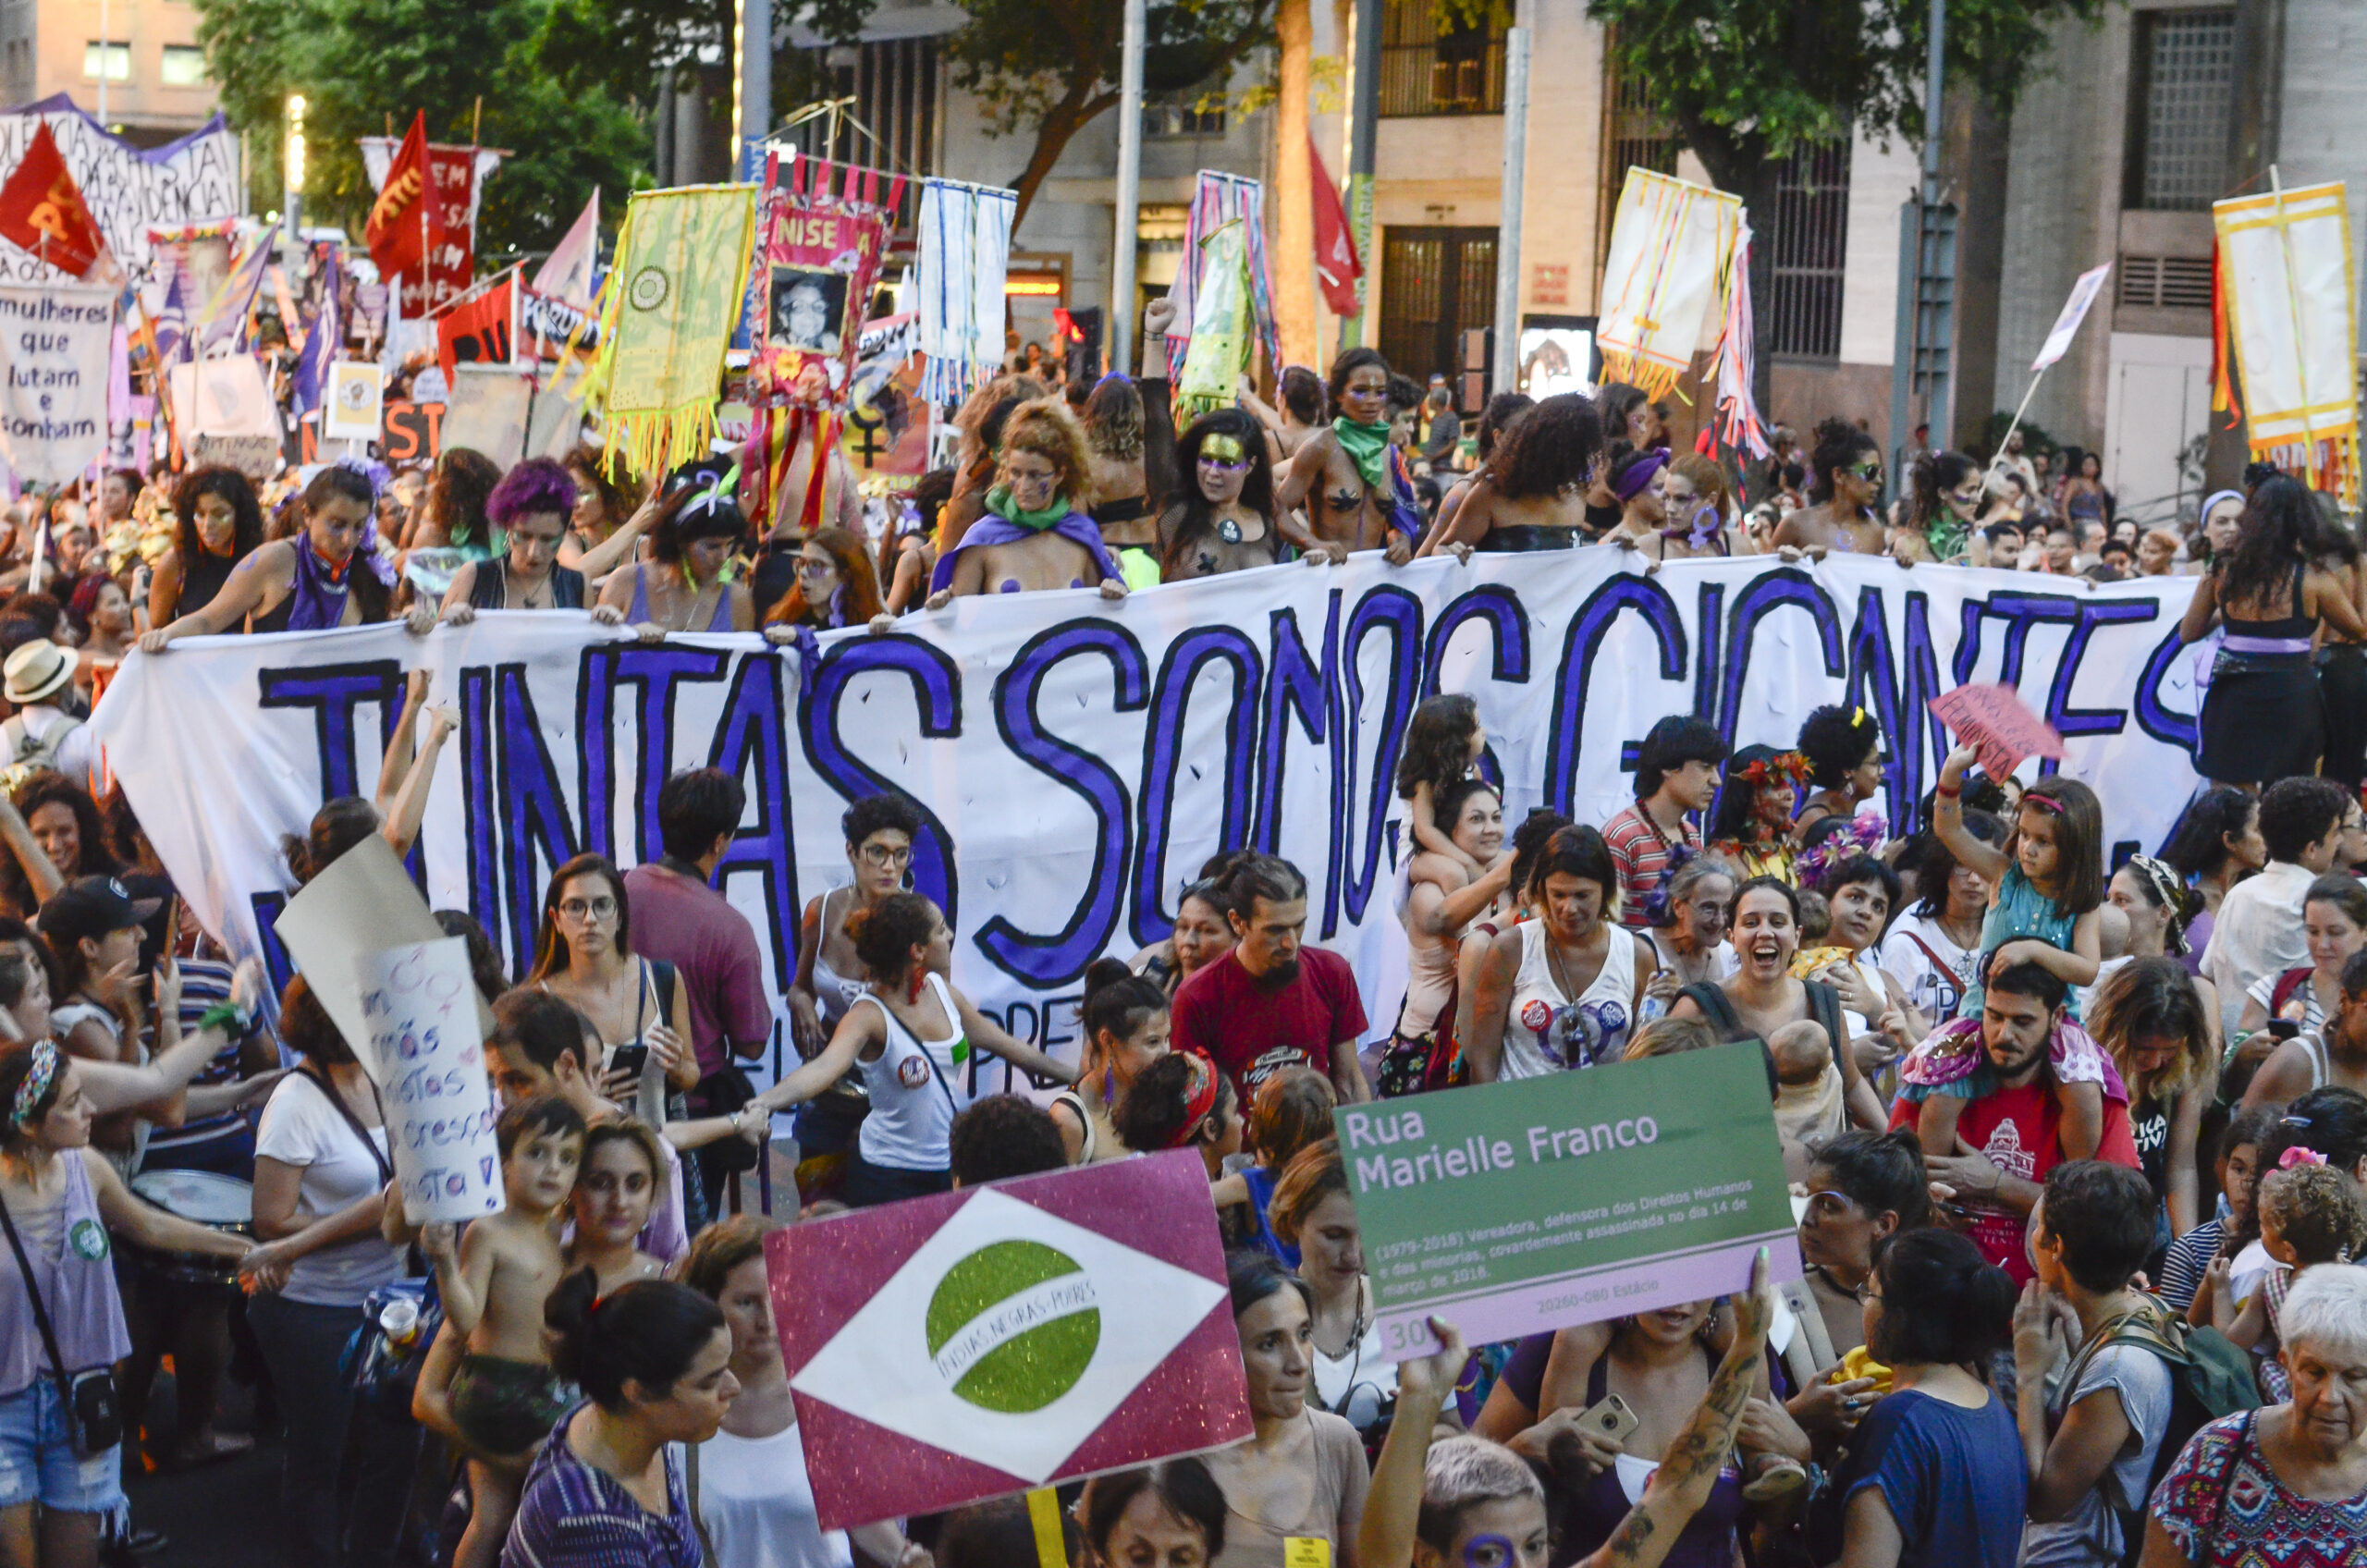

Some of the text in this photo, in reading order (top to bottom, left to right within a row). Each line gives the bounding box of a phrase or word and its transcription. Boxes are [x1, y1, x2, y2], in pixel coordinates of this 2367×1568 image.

[778, 217, 838, 250] NISE
[1354, 180, 1374, 307] ROOVIÁRIA
[0, 298, 107, 323] mulheres
[20, 332, 69, 356] que
[8, 365, 80, 387] lutam
[40, 394, 52, 410] e
[974, 583, 1531, 989] SOMOS
[1345, 1110, 1426, 1149] Rua
[1355, 1115, 1659, 1194] Marielle Franco
[1466, 1219, 1540, 1243] Vereadora,
[1544, 1206, 1609, 1229] defensora
[1613, 1200, 1636, 1216] dos
[1639, 1191, 1691, 1211] Direitos
[1694, 1180, 1753, 1200] Humanos
[1392, 1260, 1417, 1277] das
[1421, 1249, 1486, 1271] minorias,
[1489, 1230, 1583, 1258] covardemente
[1587, 1213, 1664, 1240] assassinada
[1668, 1210, 1685, 1223] no
[1688, 1204, 1709, 1220] dia
[1712, 1201, 1728, 1216] 14
[1732, 1196, 1748, 1211] de
[1430, 1274, 1449, 1289] de
[1613, 1279, 1660, 1298] Estácio
